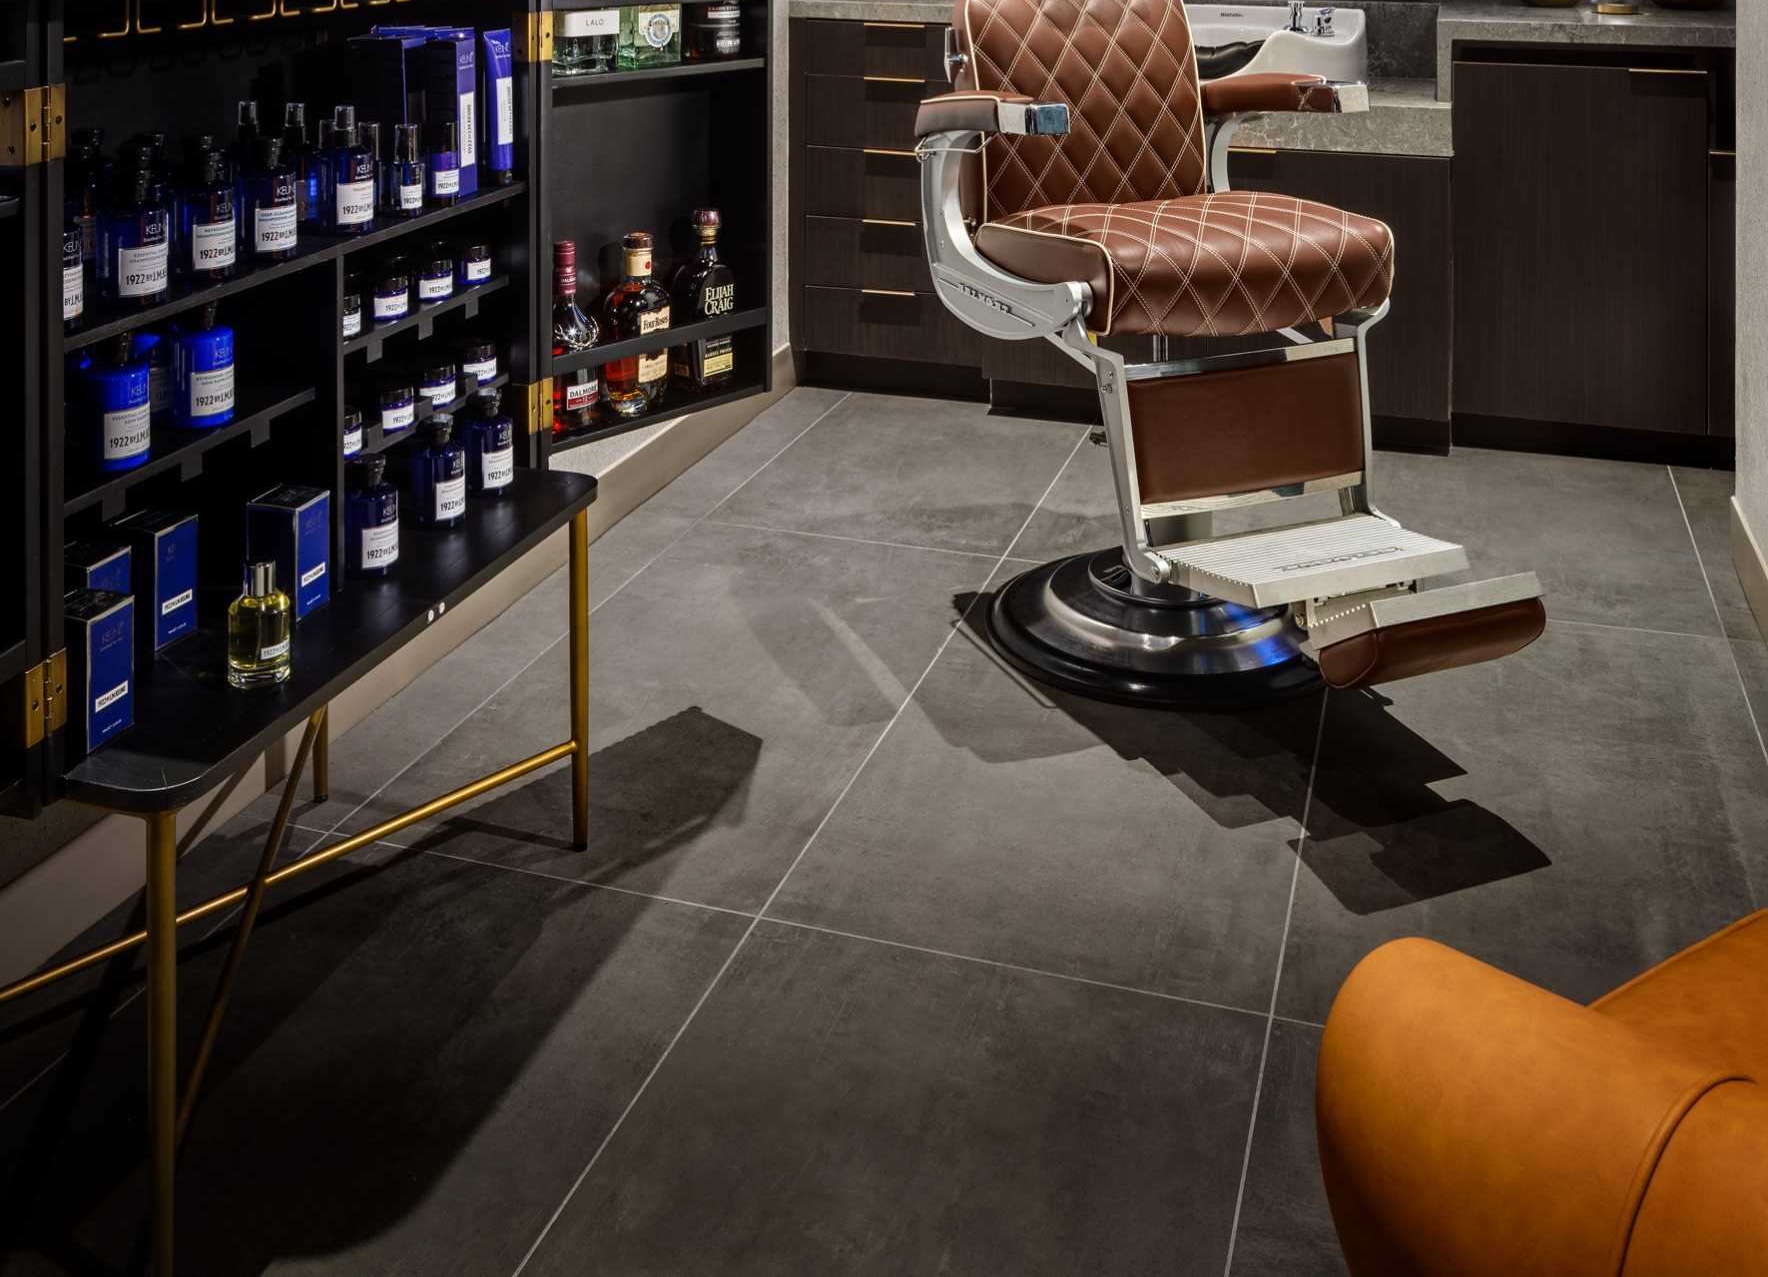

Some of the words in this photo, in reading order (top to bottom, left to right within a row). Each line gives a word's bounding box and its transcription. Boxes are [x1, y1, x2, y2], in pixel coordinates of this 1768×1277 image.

[585, 18, 604, 27] LALO
[343, 204, 358, 215] 1922
[262, 231, 279, 242] 1922
[201, 248, 217, 260] 1922
[126, 274, 145, 285] 1922
[705, 284, 735, 301] ELIJAH
[704, 297, 734, 315] CRAIG
[196, 394, 214, 407] 1922
[110, 436, 129, 449] 1922
[488, 471, 502, 482] 1922
[440, 499, 455, 512] 1922
[366, 548, 384, 560] 1922
